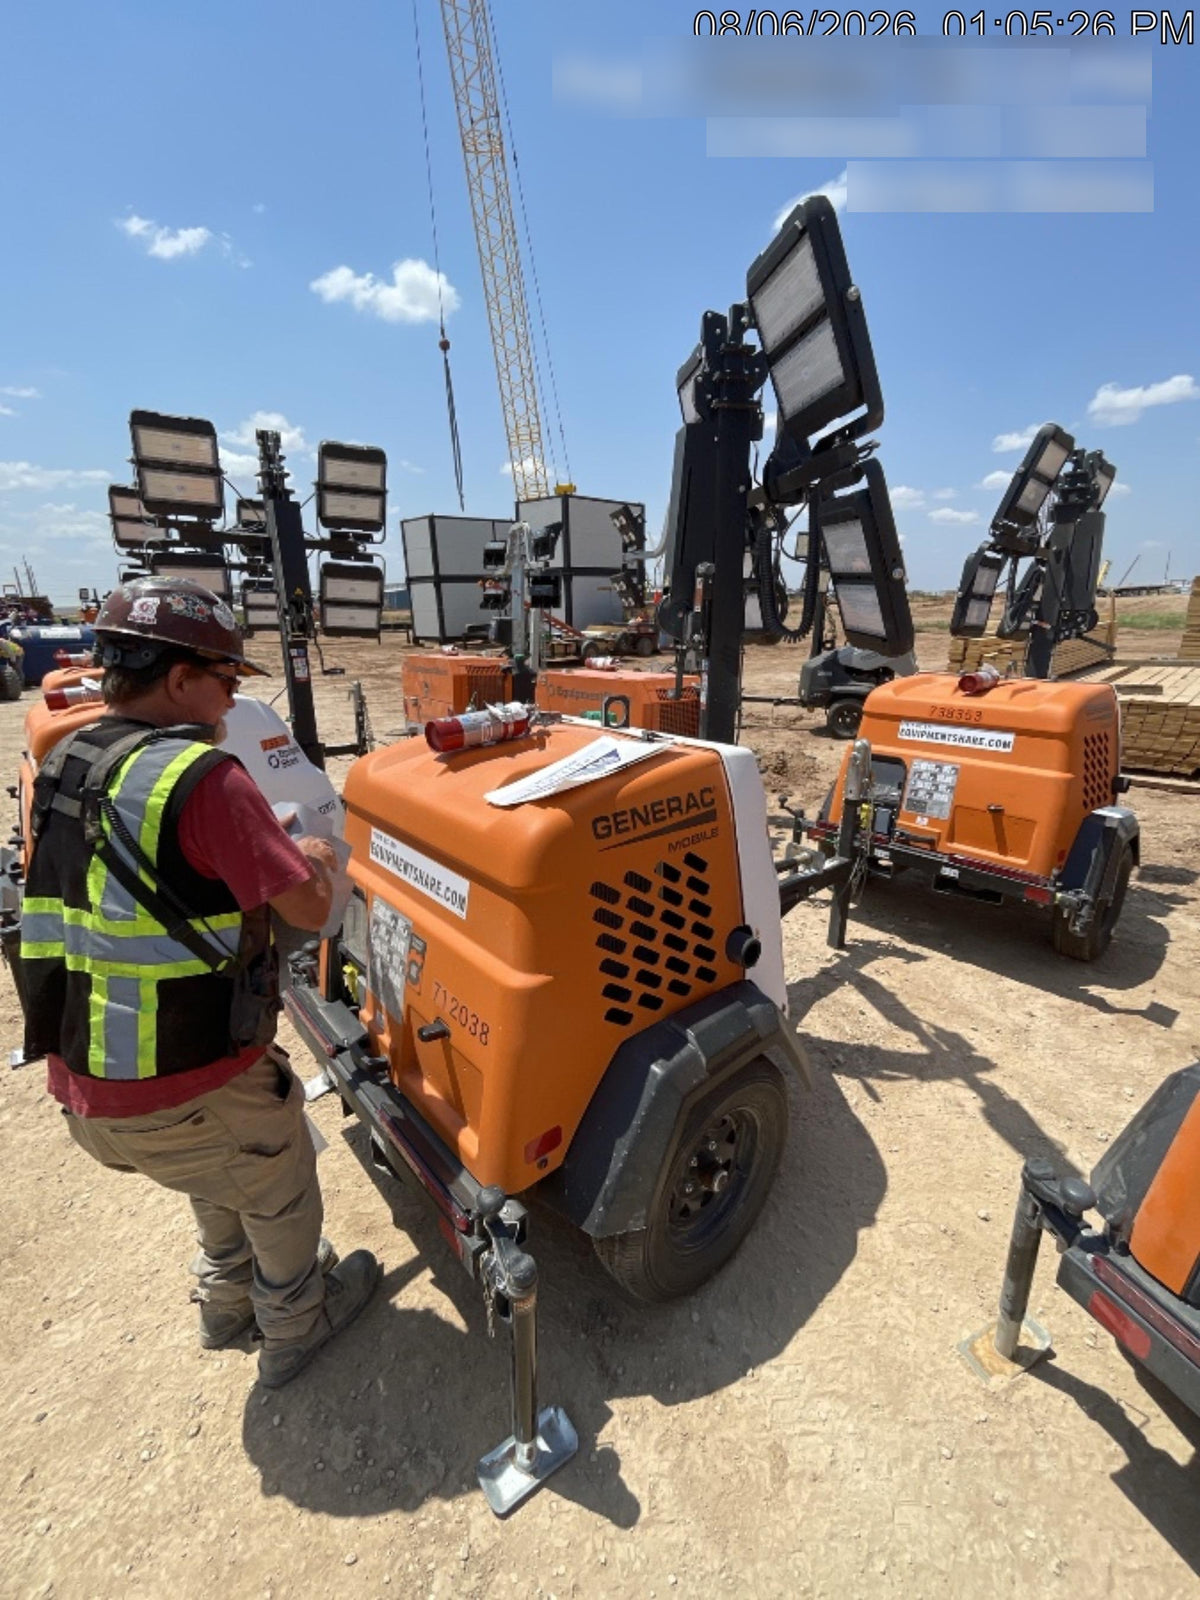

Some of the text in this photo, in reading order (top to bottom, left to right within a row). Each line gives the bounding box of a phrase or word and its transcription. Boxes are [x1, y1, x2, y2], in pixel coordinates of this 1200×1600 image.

[591, 786, 716, 840] GENERAC
[667, 826, 719, 853] MOBILE
[433, 981, 491, 1047] 712038
